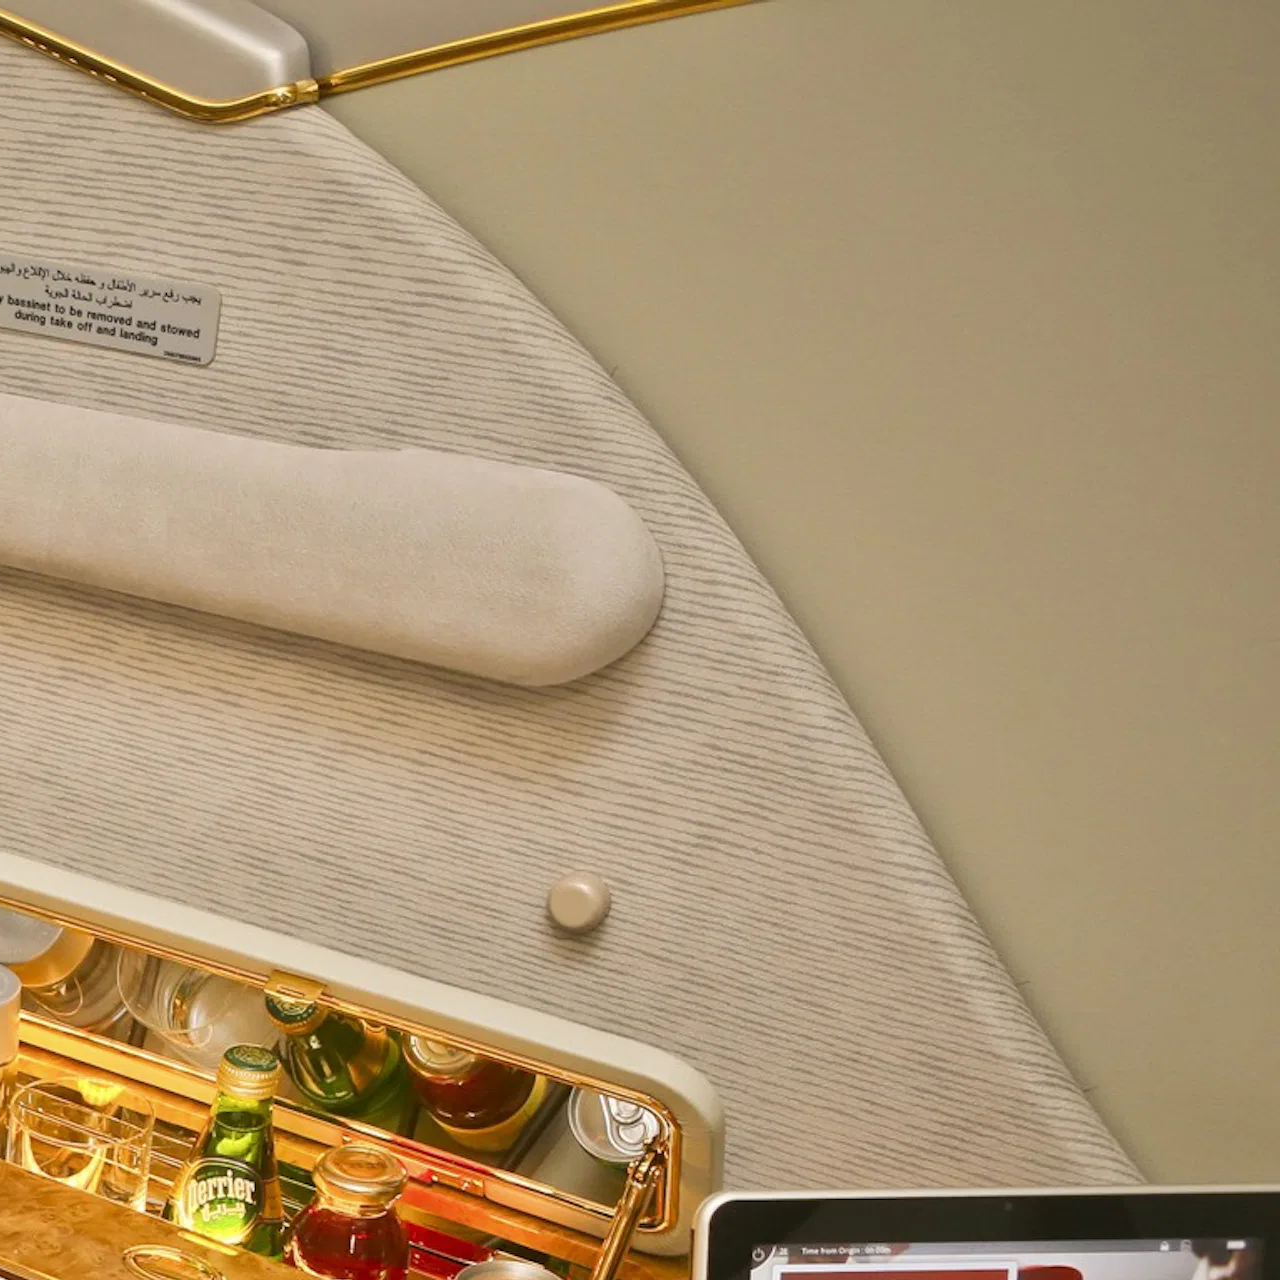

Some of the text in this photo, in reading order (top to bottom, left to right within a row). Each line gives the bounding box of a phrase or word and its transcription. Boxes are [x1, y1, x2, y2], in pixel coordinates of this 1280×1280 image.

[7, 294, 51, 312] bassinet
[55, 304, 66, 315] to
[69, 306, 83, 318] be
[87, 311, 132, 327] removed
[136, 319, 157, 331] and
[160, 323, 201, 339] stowed
[14, 310, 159, 346] during take off and landing
